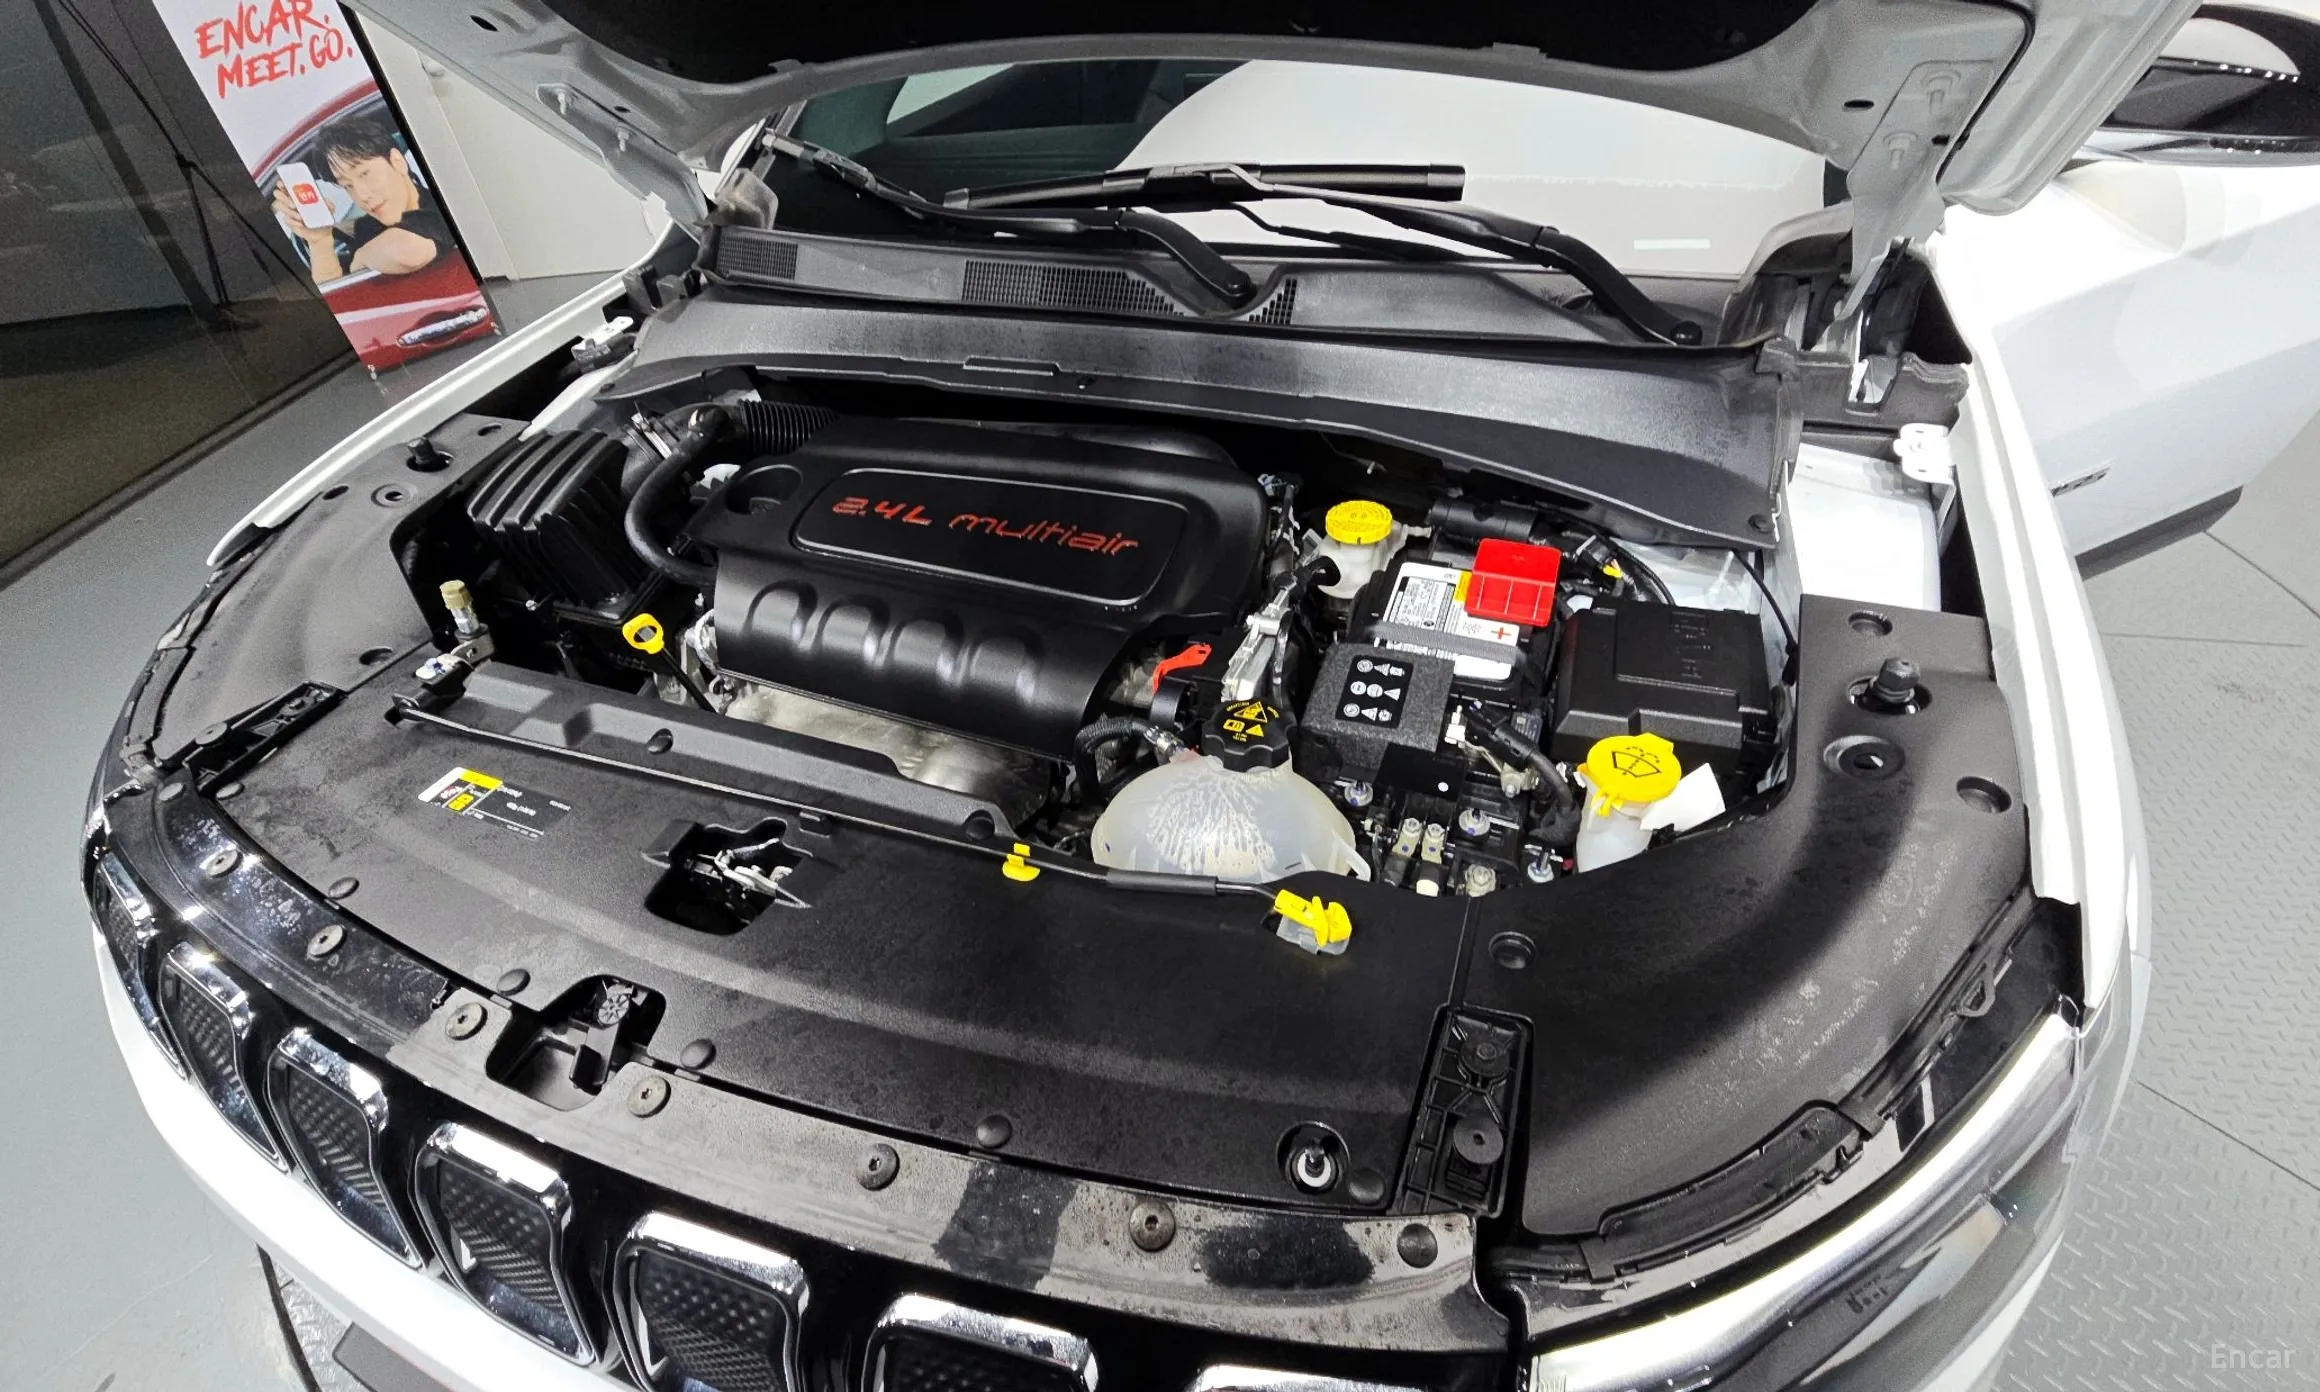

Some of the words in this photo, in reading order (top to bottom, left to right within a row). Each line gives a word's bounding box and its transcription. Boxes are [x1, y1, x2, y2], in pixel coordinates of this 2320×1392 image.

[195, 0, 329, 59] ENCAR.
[217, 42, 305, 99] MEET.
[309, 28, 353, 69] GO.
[833, 497, 932, 526] 2.4L
[949, 513, 1139, 556] multiair
